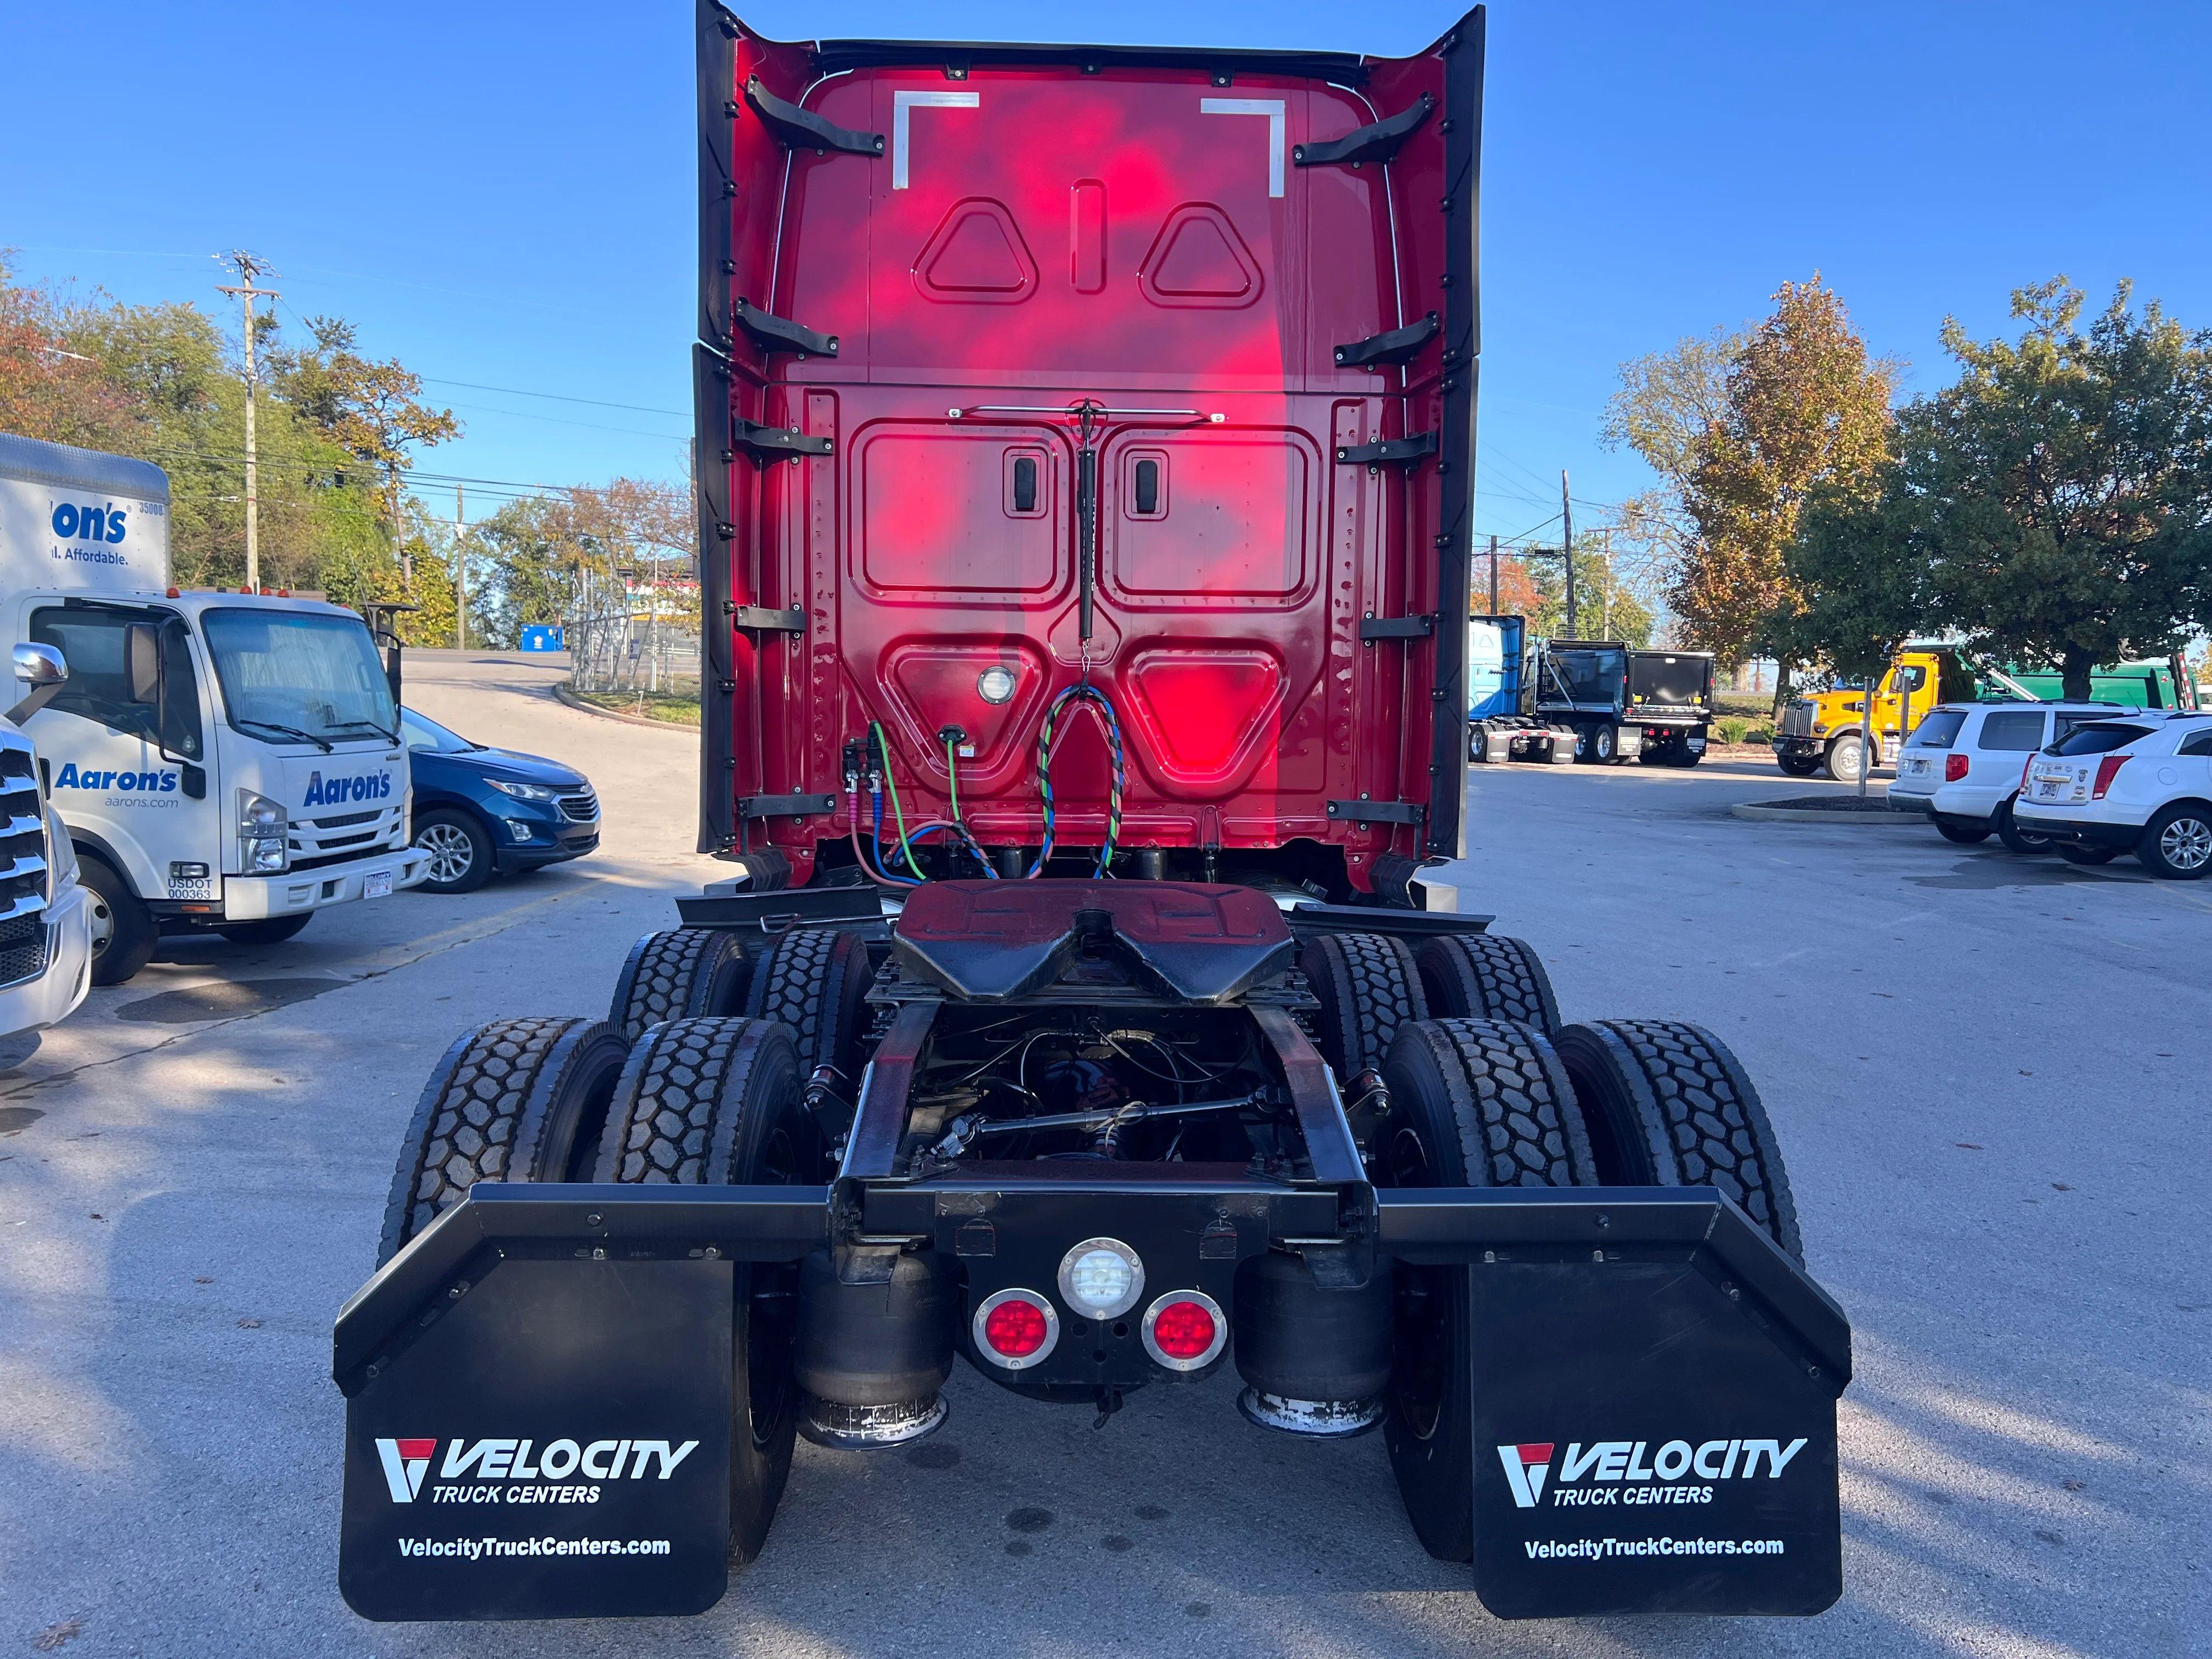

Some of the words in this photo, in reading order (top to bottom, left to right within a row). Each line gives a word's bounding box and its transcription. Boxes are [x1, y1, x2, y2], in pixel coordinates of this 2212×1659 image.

[50, 501, 127, 543] on's
[65, 548, 128, 566] Affordable.
[54, 763, 177, 792] Aaron's
[303, 769, 390, 807] Aaron's
[105, 798, 178, 808] aarons.com
[168, 878, 212, 889] USDOT
[168, 889, 211, 899] 000363
[441, 1438, 699, 1480] VELOCITY
[1560, 1438, 1808, 1481] VELOCITY
[432, 1486, 501, 1503] TRUCK
[506, 1486, 601, 1504] CENTERS
[1553, 1488, 1617, 1506] TRUCK
[1623, 1486, 1713, 1505] CENTERS
[398, 1537, 670, 1560] VelocityTruckCenters.com
[1525, 1537, 1784, 1560] VelocityTruckCenters.com
